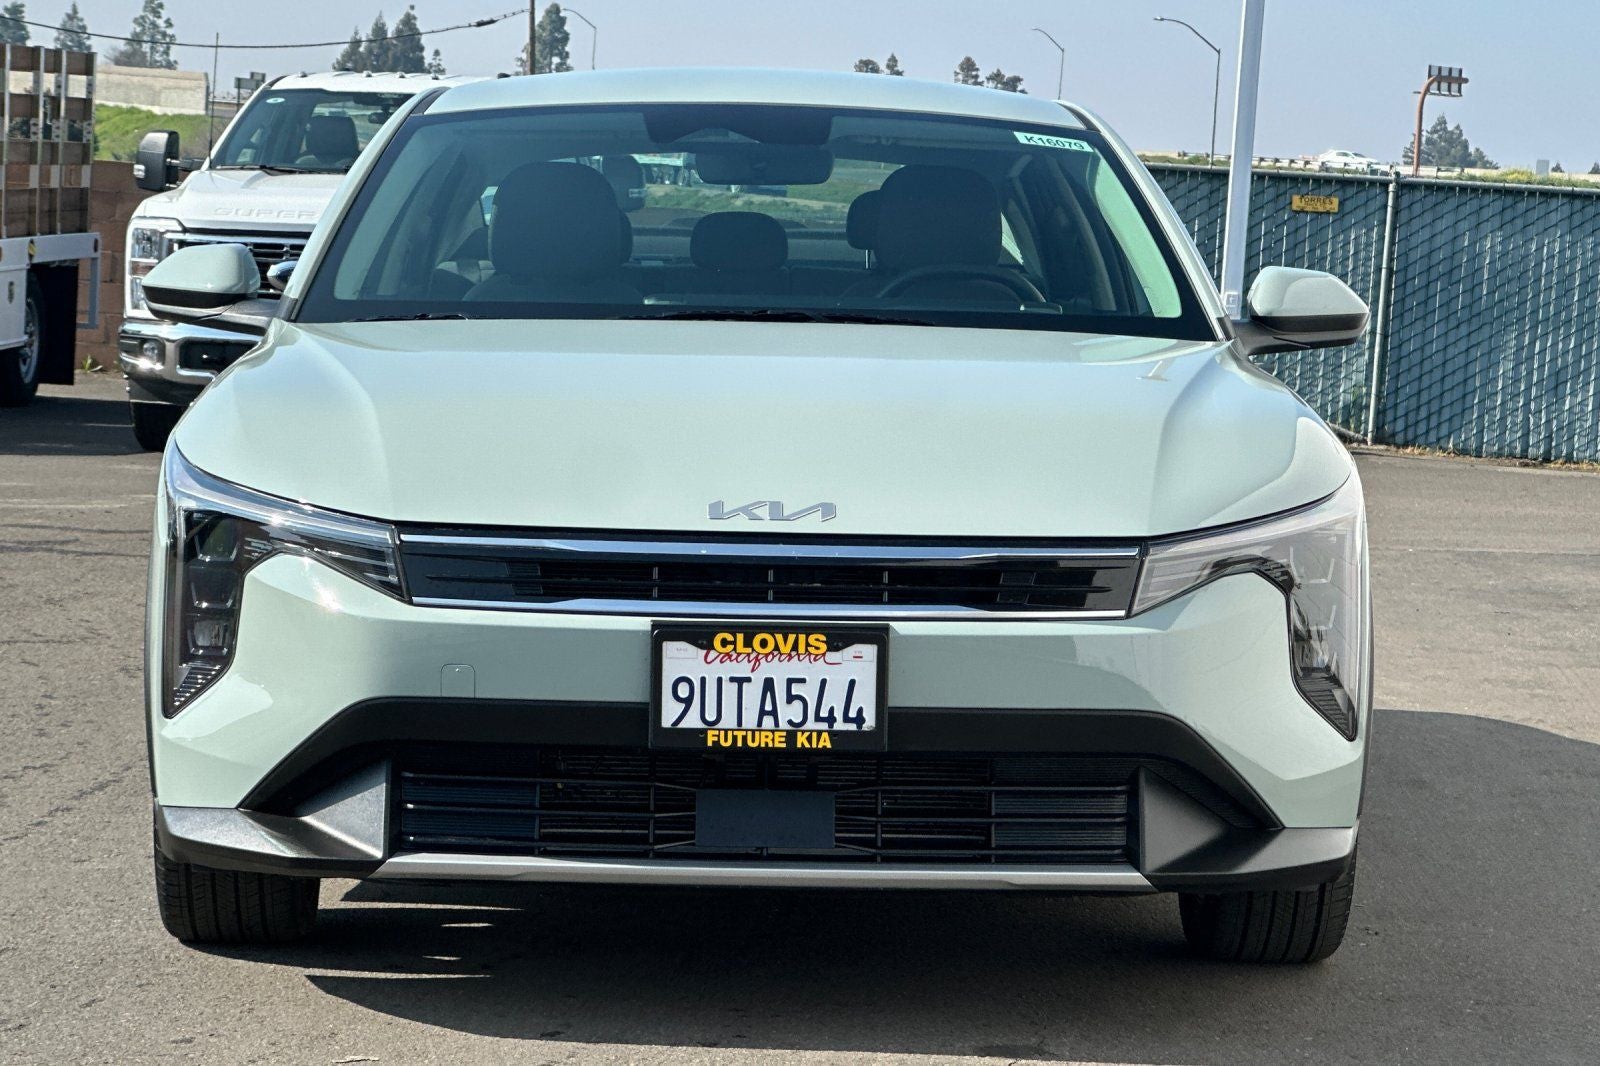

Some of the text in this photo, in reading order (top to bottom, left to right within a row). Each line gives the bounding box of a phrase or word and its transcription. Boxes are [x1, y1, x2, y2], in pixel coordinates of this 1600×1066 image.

[1024, 135, 1085, 150] K16079
[1299, 196, 1333, 206] TORRES
[707, 499, 836, 522] KIA
[713, 632, 828, 655] CLOVIS
[671, 675, 867, 730] 9UTA544
[706, 730, 832, 749] FUTURE KIA
